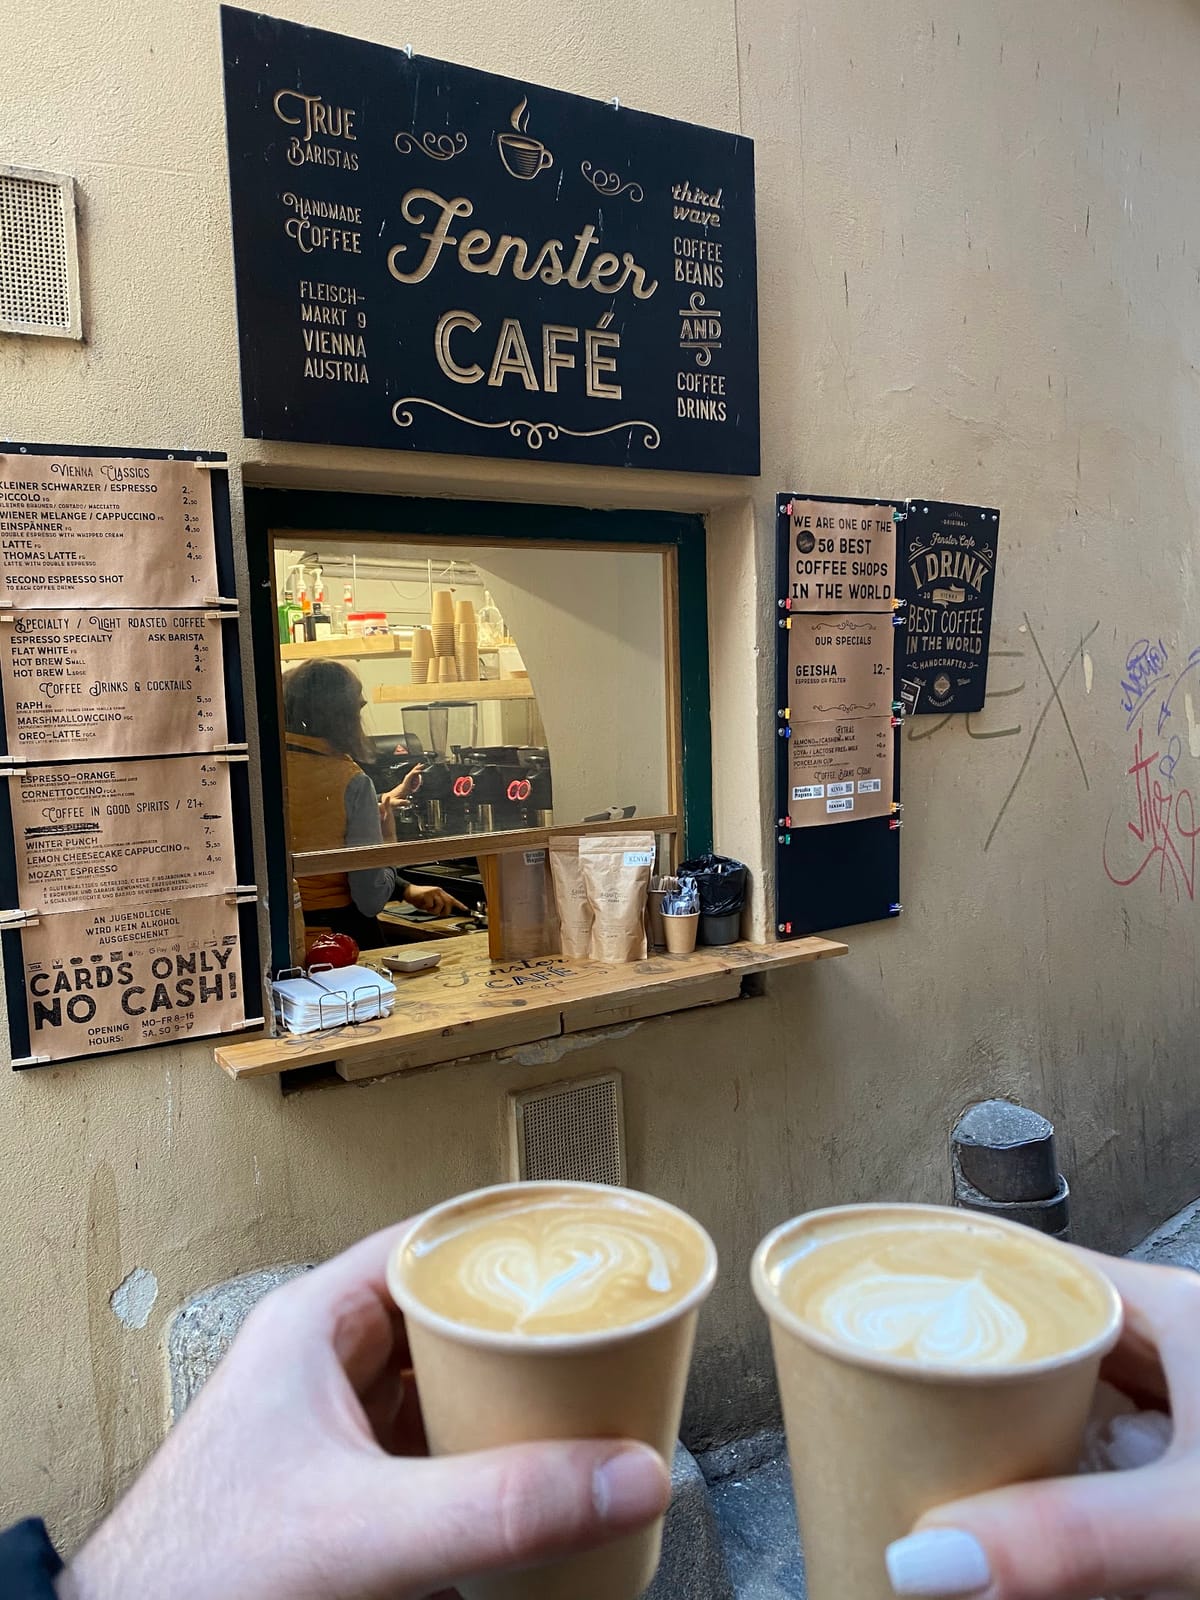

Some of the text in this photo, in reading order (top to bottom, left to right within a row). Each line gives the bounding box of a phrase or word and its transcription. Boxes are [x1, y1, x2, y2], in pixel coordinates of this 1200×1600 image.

[274, 89, 357, 141] TRUE
[288, 137, 359, 171] BARISTAS
[672, 181, 722, 209] third
[283, 192, 362, 224] HANDMADE
[673, 206, 721, 227] wave
[285, 219, 362, 253] COFFEE
[387, 188, 659, 300] Fenster
[673, 236, 723, 263] COFFEE
[674, 259, 724, 288] BEANS
[300, 280, 365, 305] FLEISCH-
[301, 304, 366, 329] MARKT 9
[680, 319, 722, 340] AND
[303, 328, 367, 358] VIENNA
[435, 312, 622, 400] CAFÉ
[304, 358, 369, 384] AUSTRIA
[677, 371, 726, 396] COFFEE
[677, 397, 727, 422] DRINKS
[51, 464, 93, 477] VIENNA
[41, 482, 101, 492] SCHWARZER
[111, 484, 158, 493] ESPRESSO
[183, 497, 198, 505] 2.50
[40, 512, 87, 520] MELANGE
[96, 513, 156, 521] CAPPUCCINO
[184, 514, 199, 522] 3.50
[794, 516, 892, 532] WE ARE ONE OF THE
[0, 521, 200, 533] EINSPÄNNER 4.50
[2, 541, 32, 549] LATTE
[818, 538, 872, 554] 50 BEST
[929, 532, 958, 547] Fenster
[3, 552, 45, 560] THOMAS
[48, 552, 77, 560] LATTE
[796, 560, 888, 576] COFFEE SHOPS
[910, 550, 989, 592] I DRINK
[6, 576, 46, 584] SECOND
[48, 576, 97, 584] ESPRESSO
[99, 575, 124, 583] SHOT
[792, 583, 891, 599] IN THE WORLD
[15, 617, 70, 633] SPECIALTY
[128, 617, 167, 628] ROASTED
[173, 617, 205, 627] COFFEE
[908, 604, 984, 635] BEST COFFEE
[11, 635, 61, 644] ESPRESSO
[63, 635, 113, 643] SPECIALTY
[815, 636, 871, 645] OUR SPECIALS
[906, 636, 982, 655] IN THE WORLD
[12, 647, 35, 655] FLAT
[194, 644, 208, 652] 4.50
[13, 658, 32, 666] HOT
[35, 658, 62, 666] BREW
[919, 658, 968, 670] HANDCRAFTED
[13, 669, 33, 677] HOT
[796, 665, 837, 677] GEISHA
[39, 680, 192, 698] COFFEE DRINKS & COCKTAILS
[16, 701, 43, 710] RAPH
[17, 710, 213, 725] MARSHMALLOWCCINO 4.50
[19, 730, 81, 740] OREO-LATTE
[198, 724, 214, 732] 5.50
[21, 771, 116, 785] ESPRESSO-ORANGE
[22, 786, 103, 799] CORNETTOCCINO
[42, 798, 204, 823] COFFEE IN GOOD SPIRITS 21+
[26, 839, 63, 850] WINTER
[65, 837, 98, 846] PUNCH
[27, 854, 60, 865] LEMON
[62, 849, 122, 862] CHEESECAKE
[125, 844, 182, 857] CAPPUCCINO
[28, 869, 67, 880] MOZART
[70, 865, 118, 876] ESPRESSO
[94, 908, 172, 924] AN JUGENDLICHE
[85, 918, 180, 936] WIRD KEIN ALKOHOL
[99, 929, 169, 945] AUSGESCHENKT
[30, 948, 233, 997] CARDS ONLY
[34, 972, 238, 1031] NO CASH!
[142, 1012, 194, 1028] MO-FR 8-16
[88, 1023, 130, 1036] OPENING
[159, 1027, 171, 1035] SO
[89, 1035, 124, 1046] HOURS:
